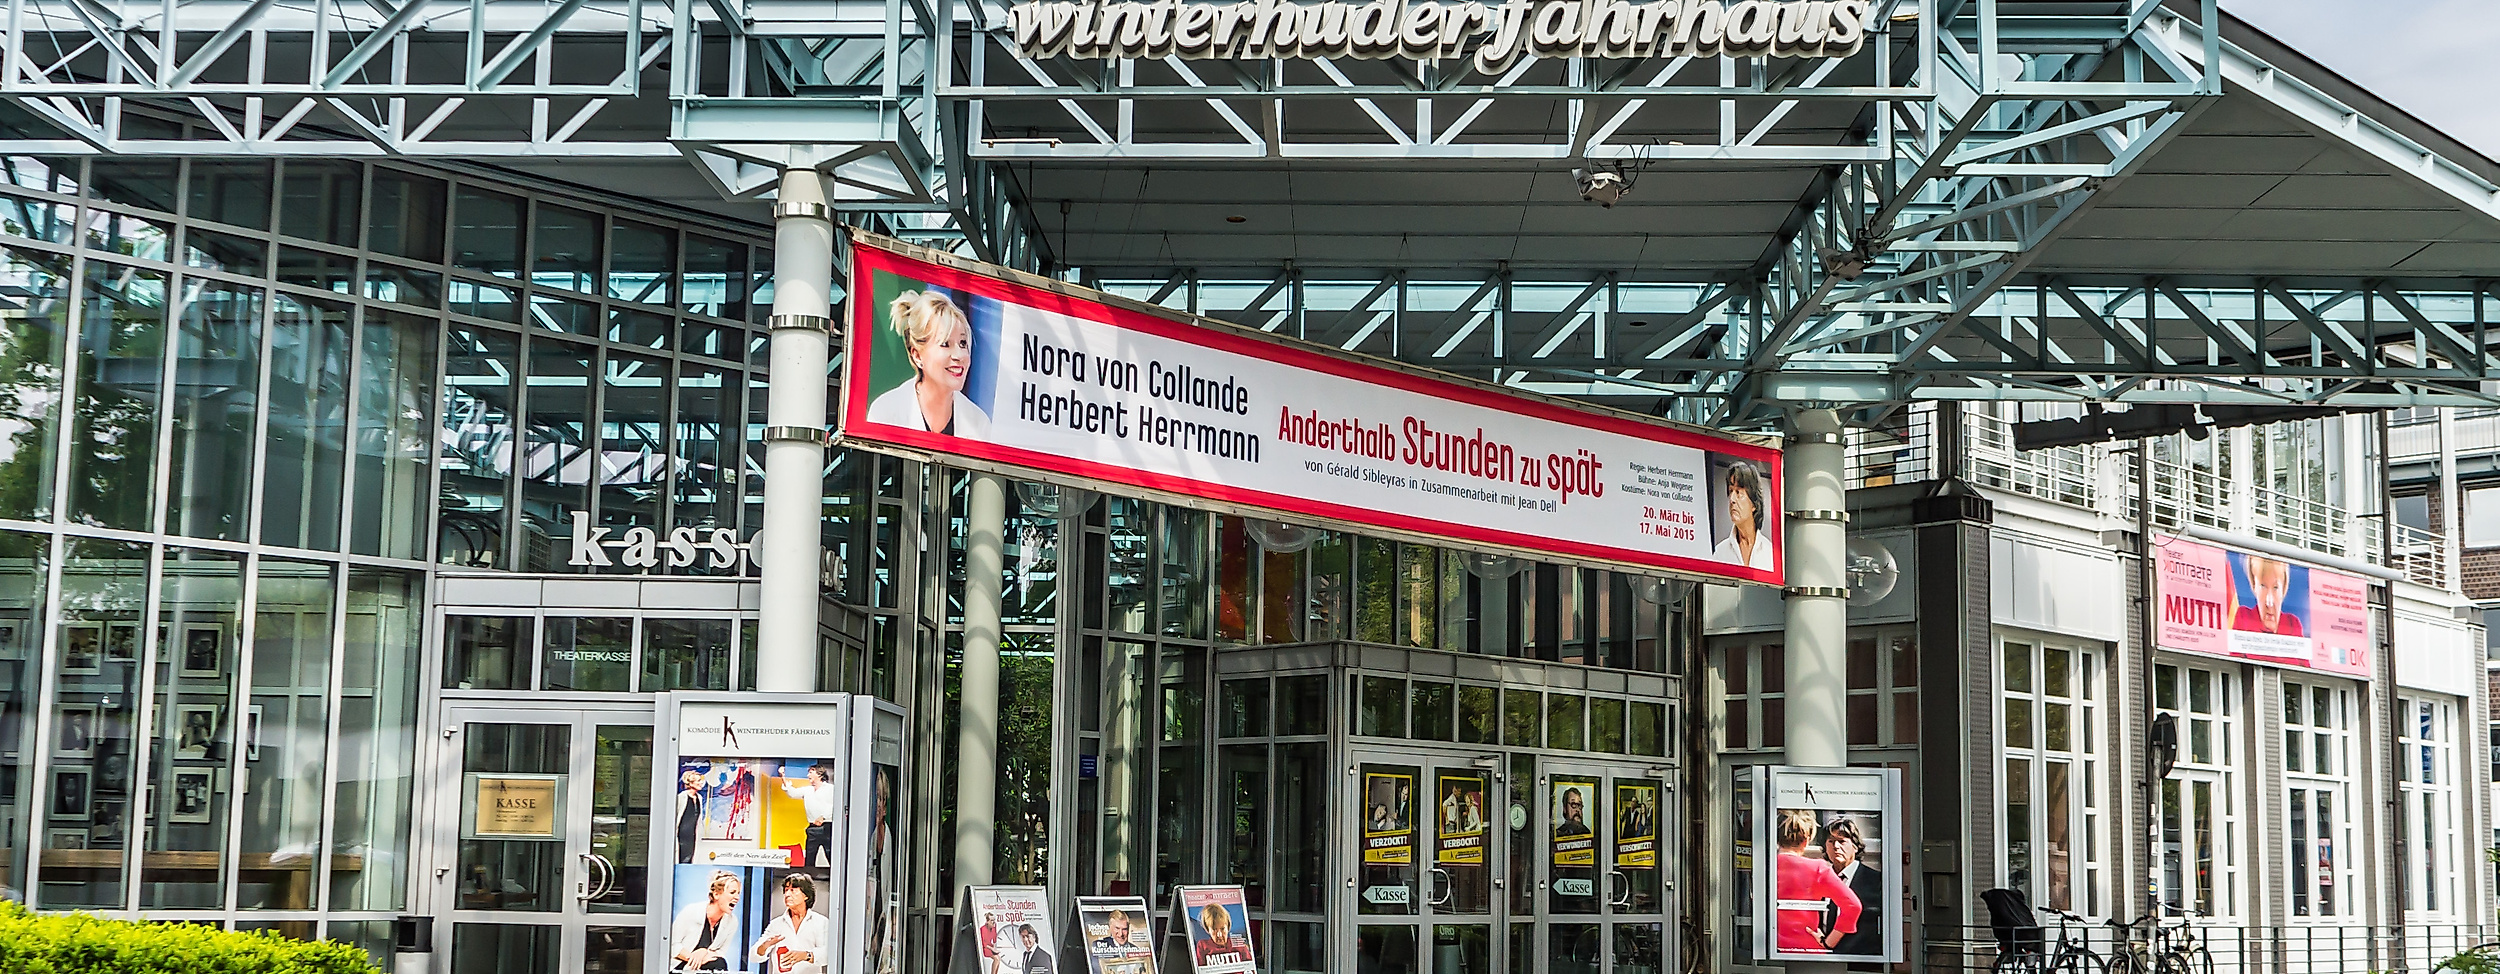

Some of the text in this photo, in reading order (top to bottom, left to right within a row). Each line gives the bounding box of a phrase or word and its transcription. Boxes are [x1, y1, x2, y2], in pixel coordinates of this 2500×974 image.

[1022, 332, 1249, 416] Nora von Collande
[1020, 381, 1260, 463] Herbert Herrmann
[1278, 405, 1604, 505] Anderthalb Stunden zu spät
[1304, 460, 1558, 513] von Gérald Sibleyras in Zusammenarbeit mit Jean Dell
[1643, 506, 1695, 525] 20. März bis
[1639, 522, 1695, 541] 17. Mai 2015
[2165, 593, 2222, 630] MUTTI
[554, 651, 631, 663] THEATERKASSE
[737, 728, 791, 736] WINTERHUDER
[790, 727, 831, 736] FÄHRHAUS
[496, 798, 536, 809] KASSE
[1374, 887, 1407, 902] Kasse
[1562, 880, 1590, 894] Kasse
[1006, 899, 1037, 910] Stunden
[1205, 951, 1241, 967] MUTTI
